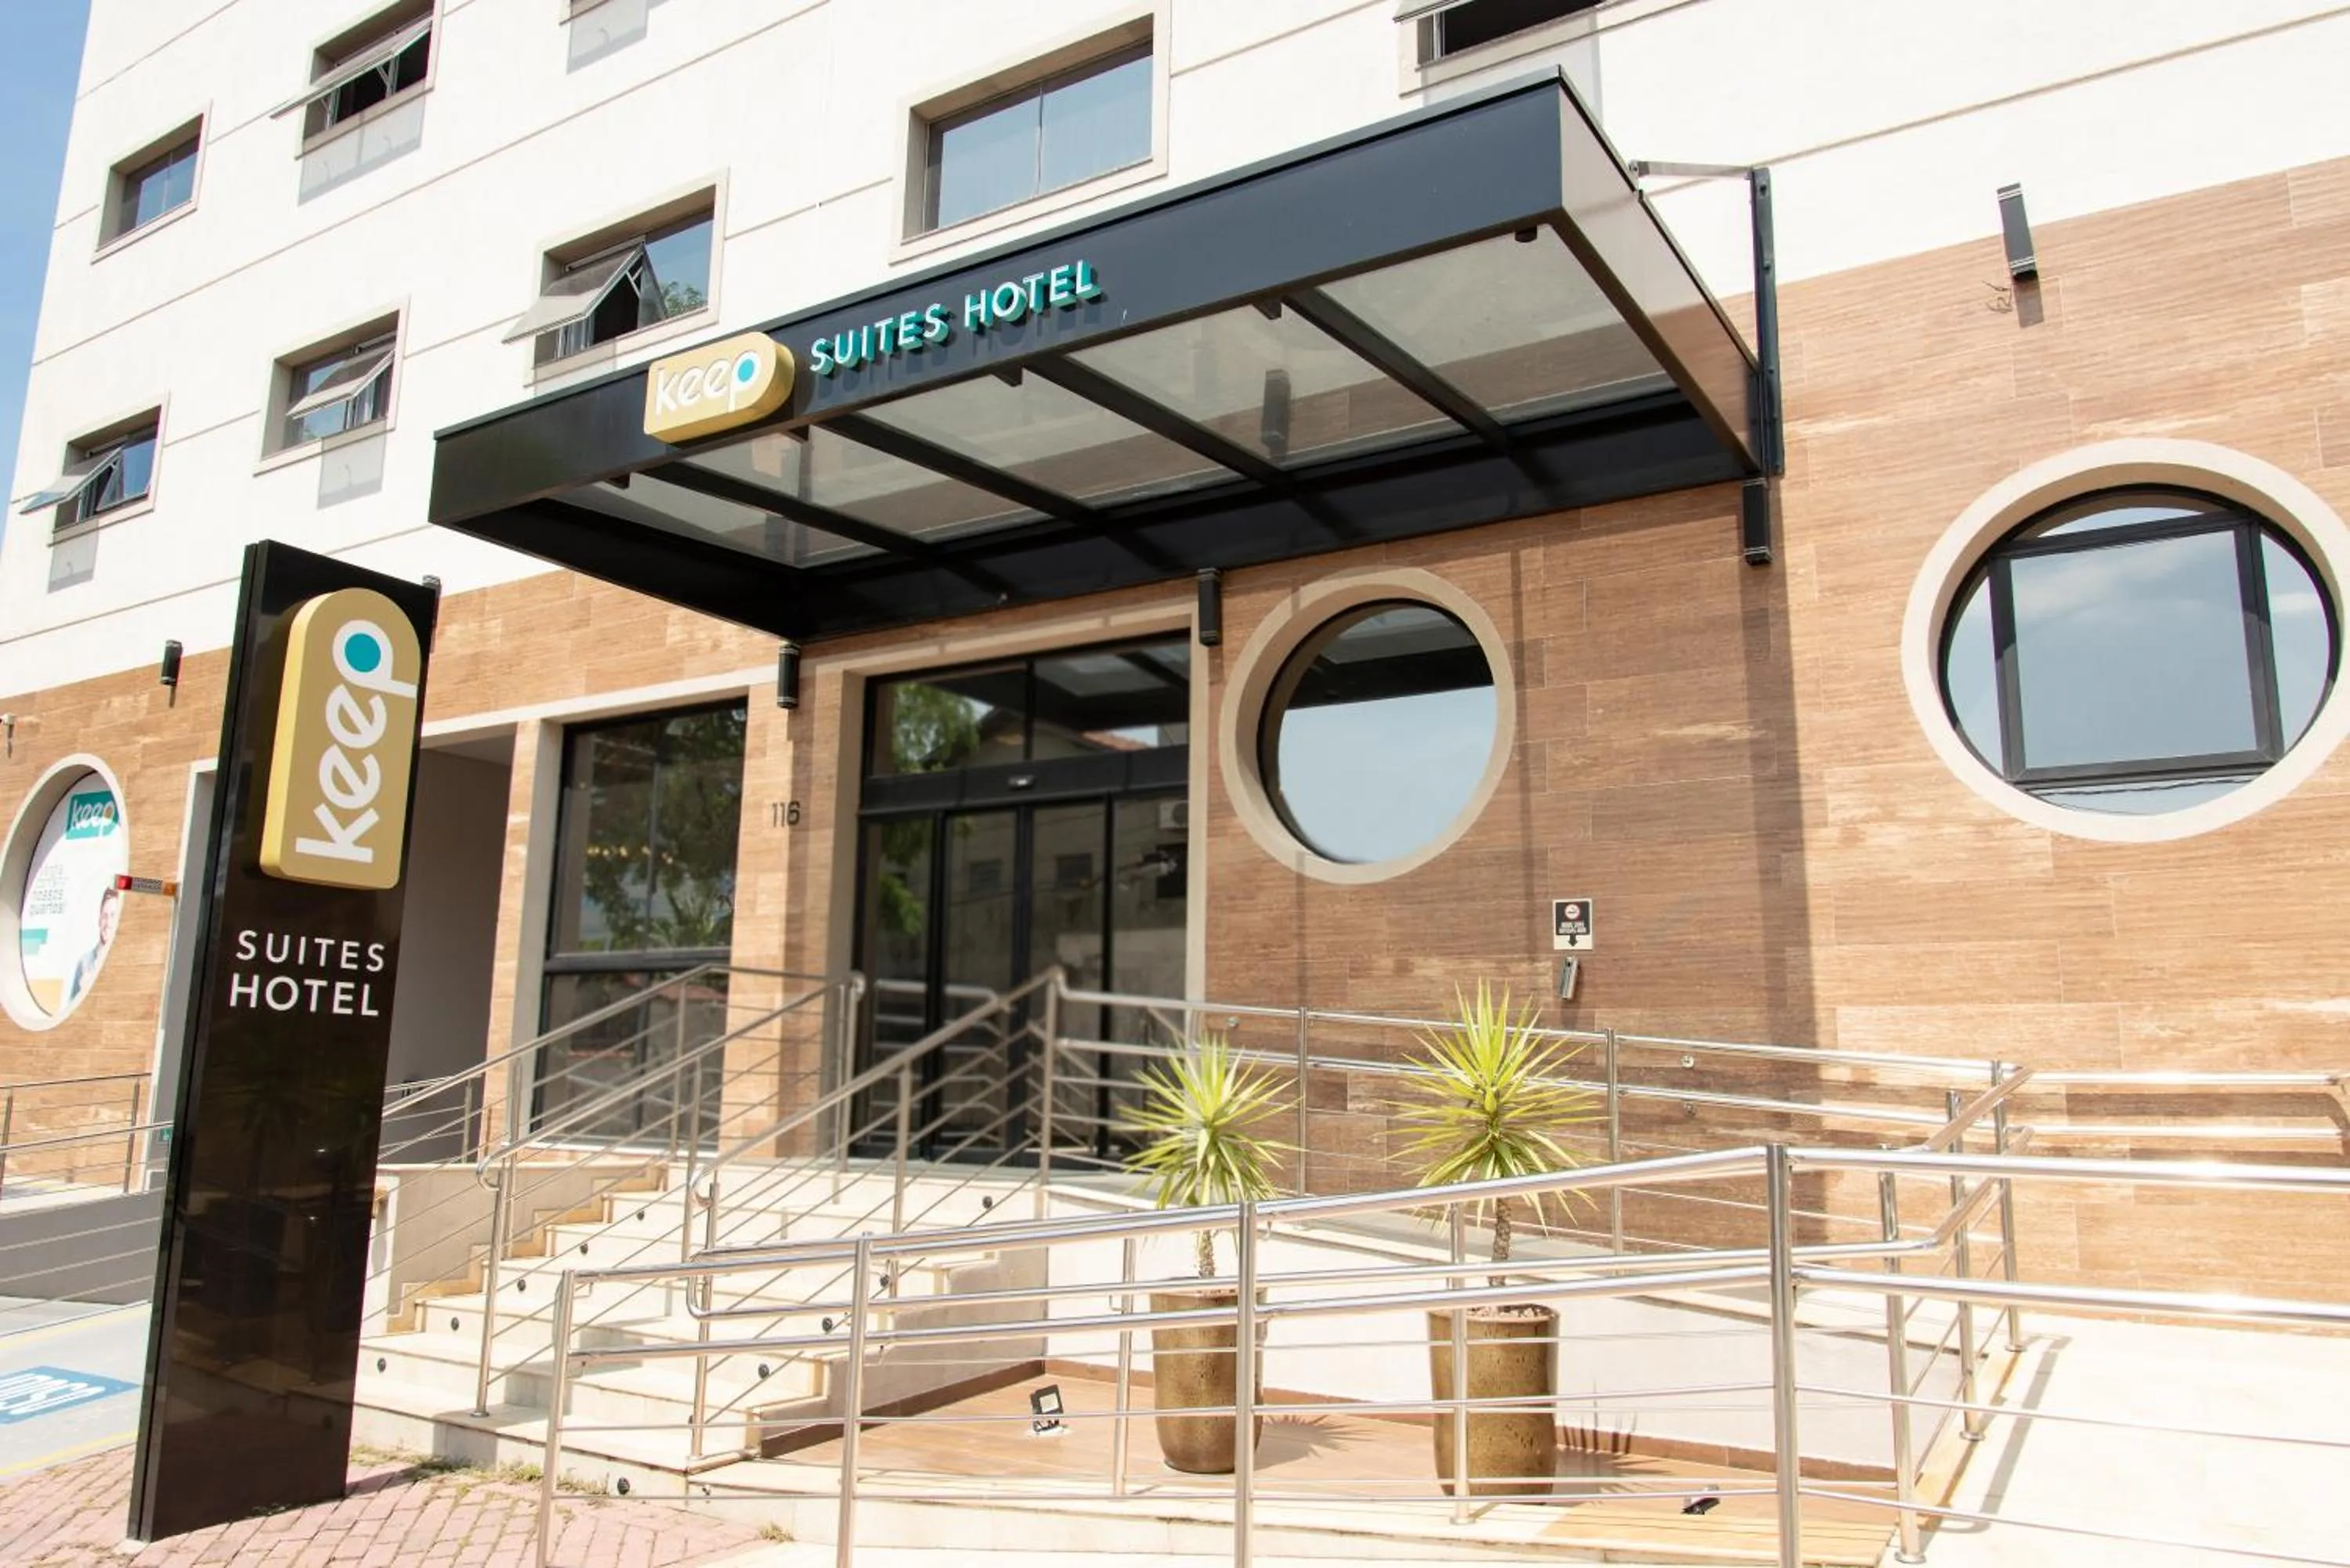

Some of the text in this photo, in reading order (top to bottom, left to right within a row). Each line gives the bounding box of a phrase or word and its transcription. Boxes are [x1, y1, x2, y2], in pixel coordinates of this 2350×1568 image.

[809, 259, 1099, 373] SUITES HOTEL
[653, 351, 763, 418] keep
[295, 619, 418, 864] keep
[71, 799, 115, 836] keep
[772, 800, 801, 827] 116
[236, 929, 385, 972] SUITES
[230, 972, 380, 1017] HOTEL
